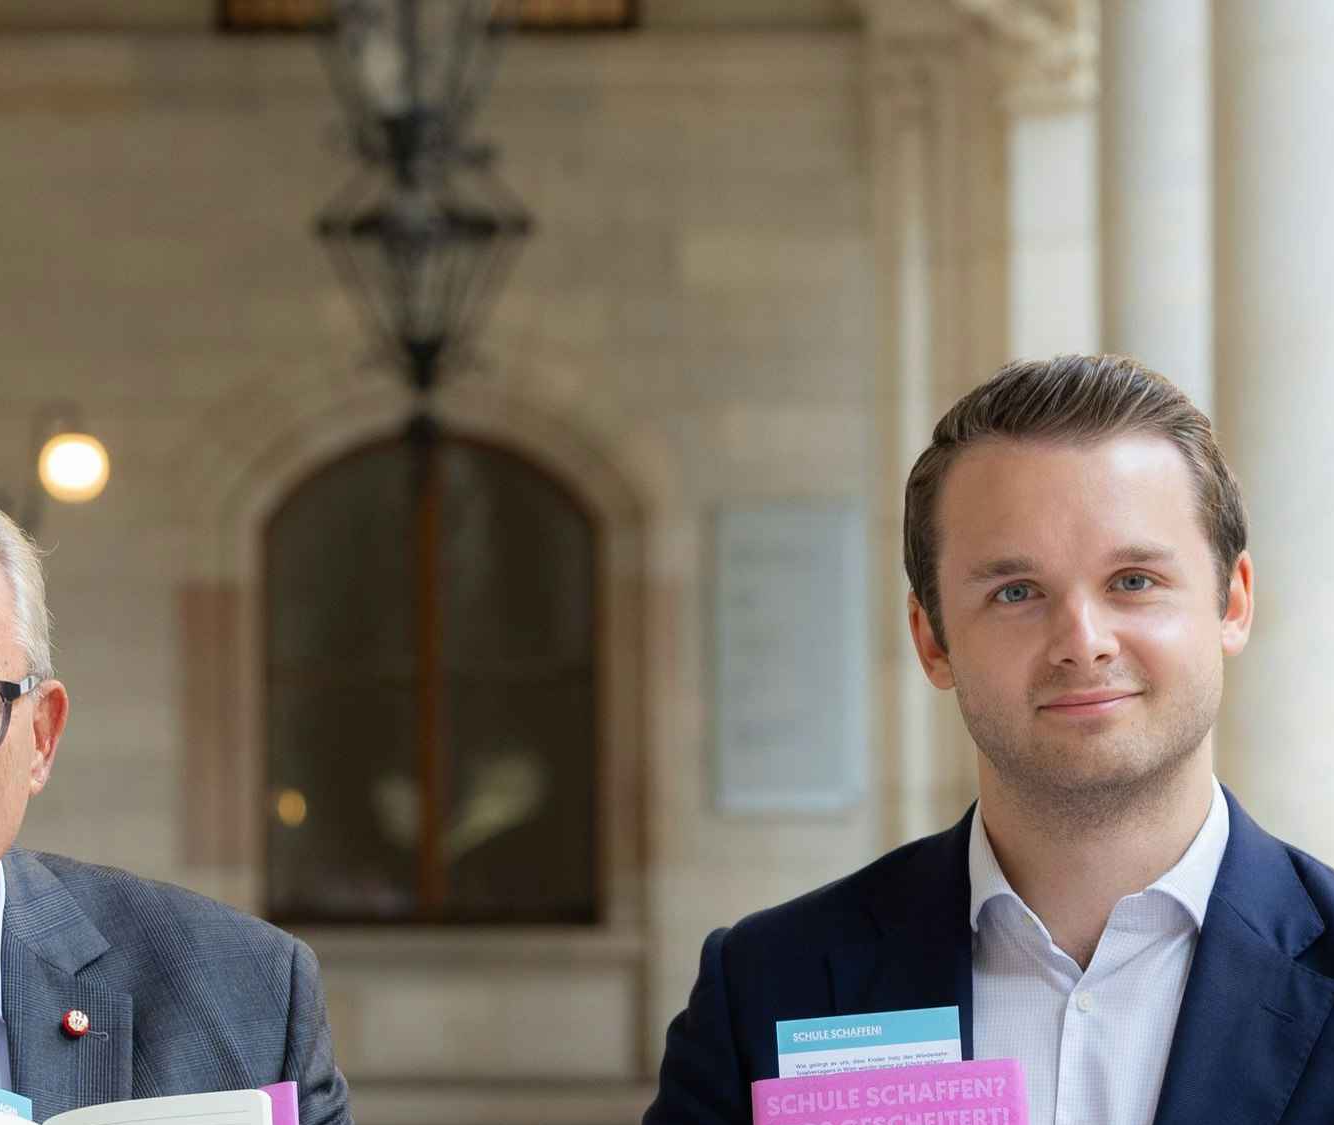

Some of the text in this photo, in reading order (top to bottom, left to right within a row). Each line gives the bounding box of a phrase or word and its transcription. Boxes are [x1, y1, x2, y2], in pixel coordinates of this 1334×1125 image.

[793, 1025, 882, 1042] SCHULE SCHAFFEN!
[767, 1077, 1007, 1117] SCHULE SCHAFFEN?
